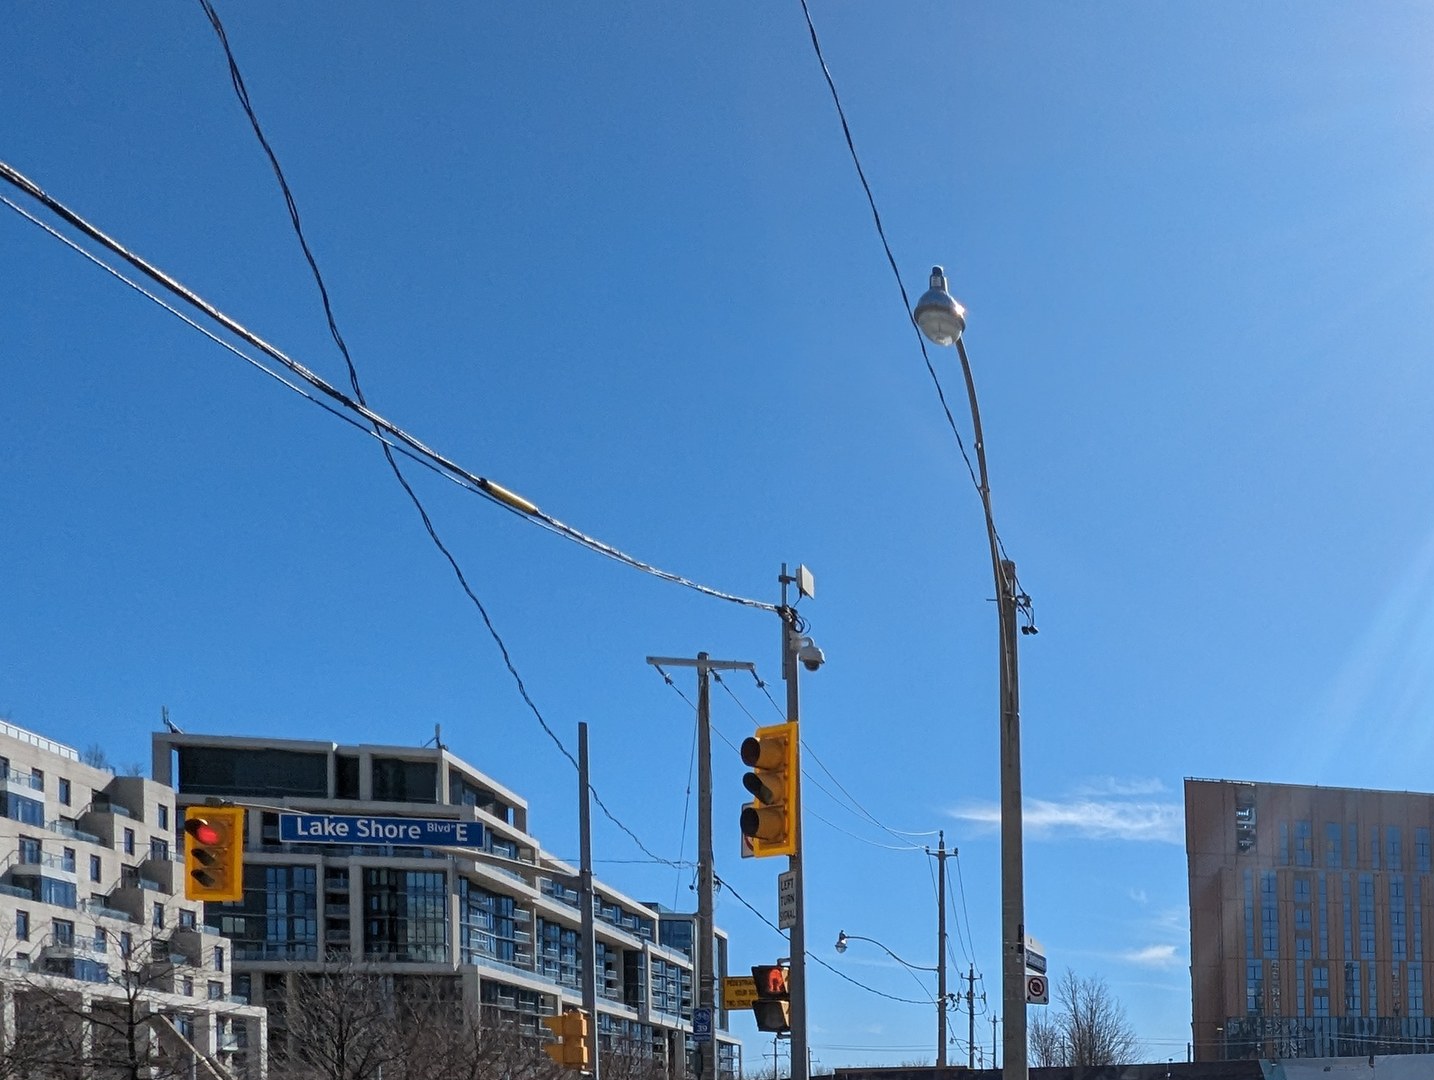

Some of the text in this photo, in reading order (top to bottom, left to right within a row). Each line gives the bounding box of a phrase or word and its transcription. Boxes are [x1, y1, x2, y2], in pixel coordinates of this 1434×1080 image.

[297, 817, 468, 842] Lake Shore Blvd E
[780, 878, 794, 891] LEFT
[780, 894, 795, 907] TURN
[779, 910, 796, 922] SIGNAL
